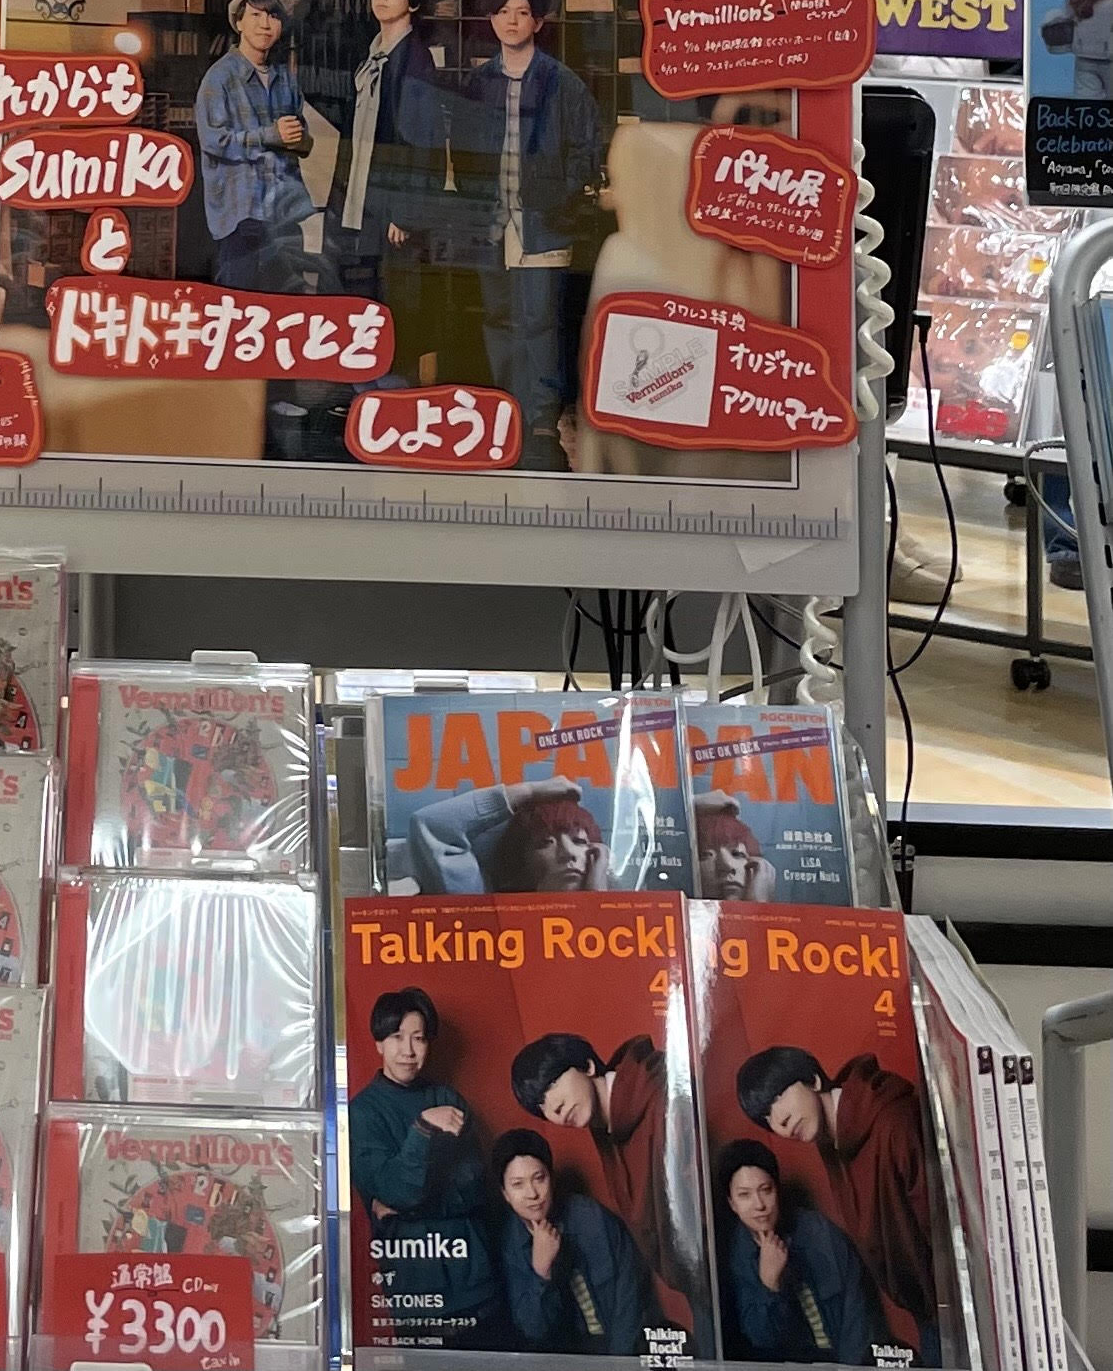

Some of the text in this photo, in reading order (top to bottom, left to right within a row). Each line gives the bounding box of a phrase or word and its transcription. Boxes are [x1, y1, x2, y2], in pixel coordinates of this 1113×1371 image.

[1037, 104, 1094, 130] Back To
[89, 218, 126, 271] と
[55, 288, 386, 371] ドキドキすることを
[729, 343, 816, 379] オリジナル
[538, 726, 604, 748] ONE OK ROCK
[695, 749, 715, 761] ONE
[717, 746, 730, 757] OK
[733, 740, 761, 754] ROCK
[394, 711, 678, 793] JAPAN
[351, 915, 677, 968] Talking Rock!
[767, 929, 901, 978] Rock!
[649, 969, 668, 997] 4
[874, 990, 896, 1017] 4
[370, 1233, 468, 1259] sumika
[182, 1277, 203, 1294] CD
[372, 1271, 396, 1285] ゆず
[371, 1294, 444, 1308] SixTONES
[85, 1290, 226, 1354] ¥3300
[644, 1328, 687, 1344] Talking
